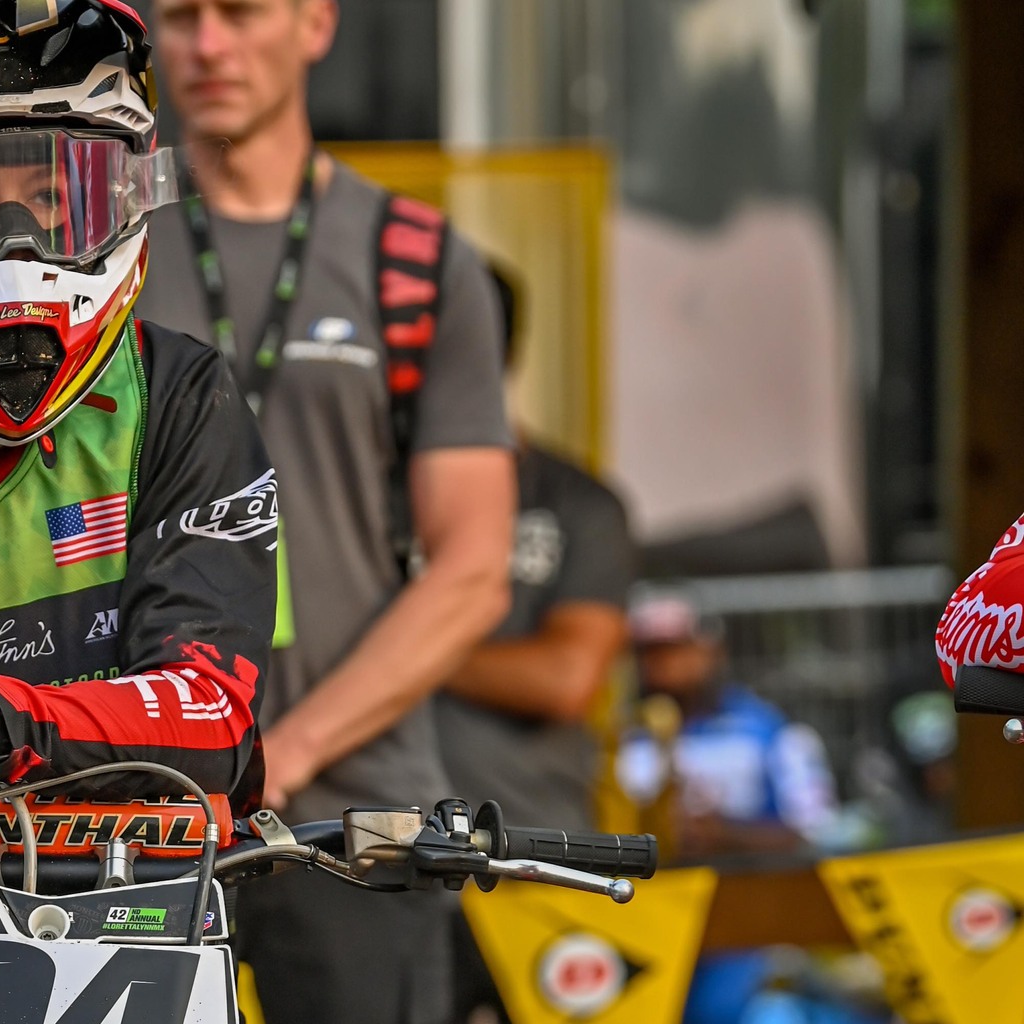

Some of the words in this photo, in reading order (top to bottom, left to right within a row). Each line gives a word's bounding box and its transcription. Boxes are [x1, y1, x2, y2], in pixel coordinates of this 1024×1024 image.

[1, 306, 21, 319] Lee
[22, 302, 60, 321] Designs
[109, 908, 127, 921] 42
[129, 915, 161, 923] ANNUAL
